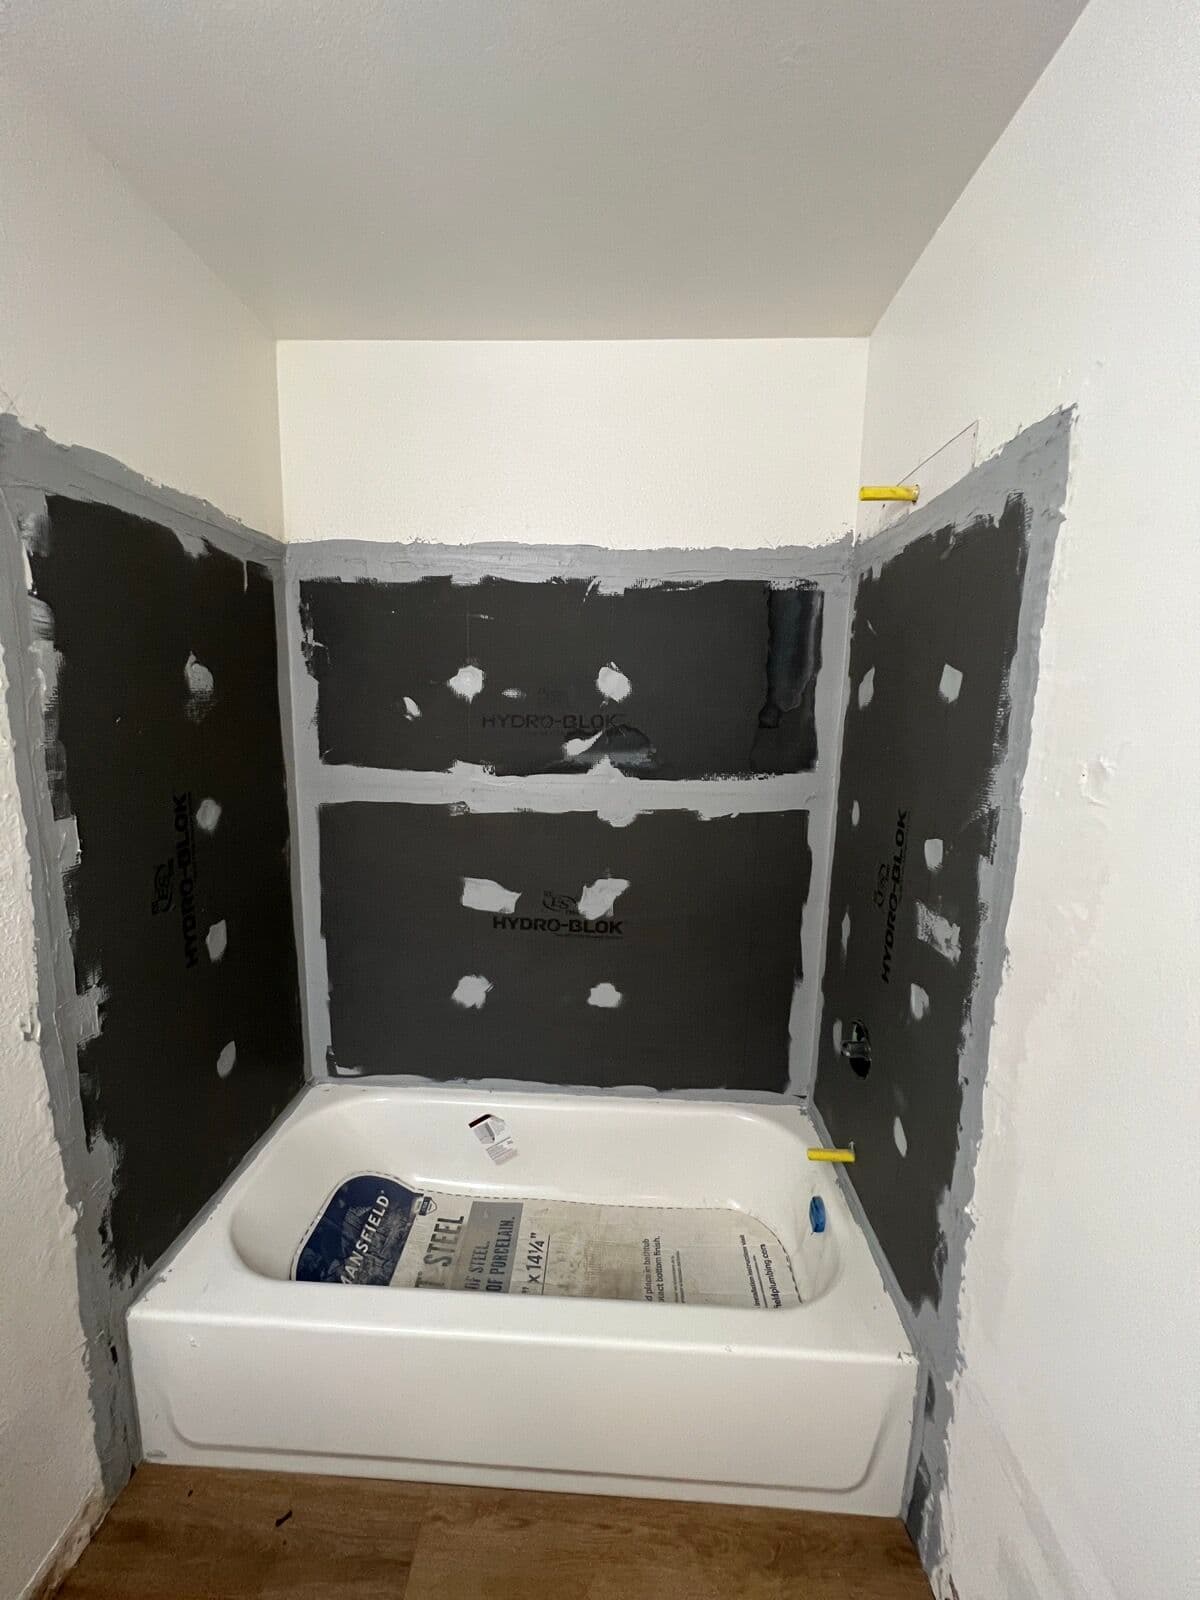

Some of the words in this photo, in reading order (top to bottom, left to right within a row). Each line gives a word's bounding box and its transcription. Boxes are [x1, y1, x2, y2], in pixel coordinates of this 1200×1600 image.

[482, 713, 617, 729] HYDRO-BLOK
[173, 793, 199, 968] HYDRO-BLOK
[881, 810, 907, 983] HYDRO-BLOK
[493, 917, 623, 934] HYDRO-BLOK
[423, 1216, 464, 1267] STEEL
[469, 1240, 490, 1274] STEEL.
[489, 1216, 515, 1275] PORCELAIN.
[486, 1278, 503, 1292] OF
[655, 1257, 663, 1282] bottom
